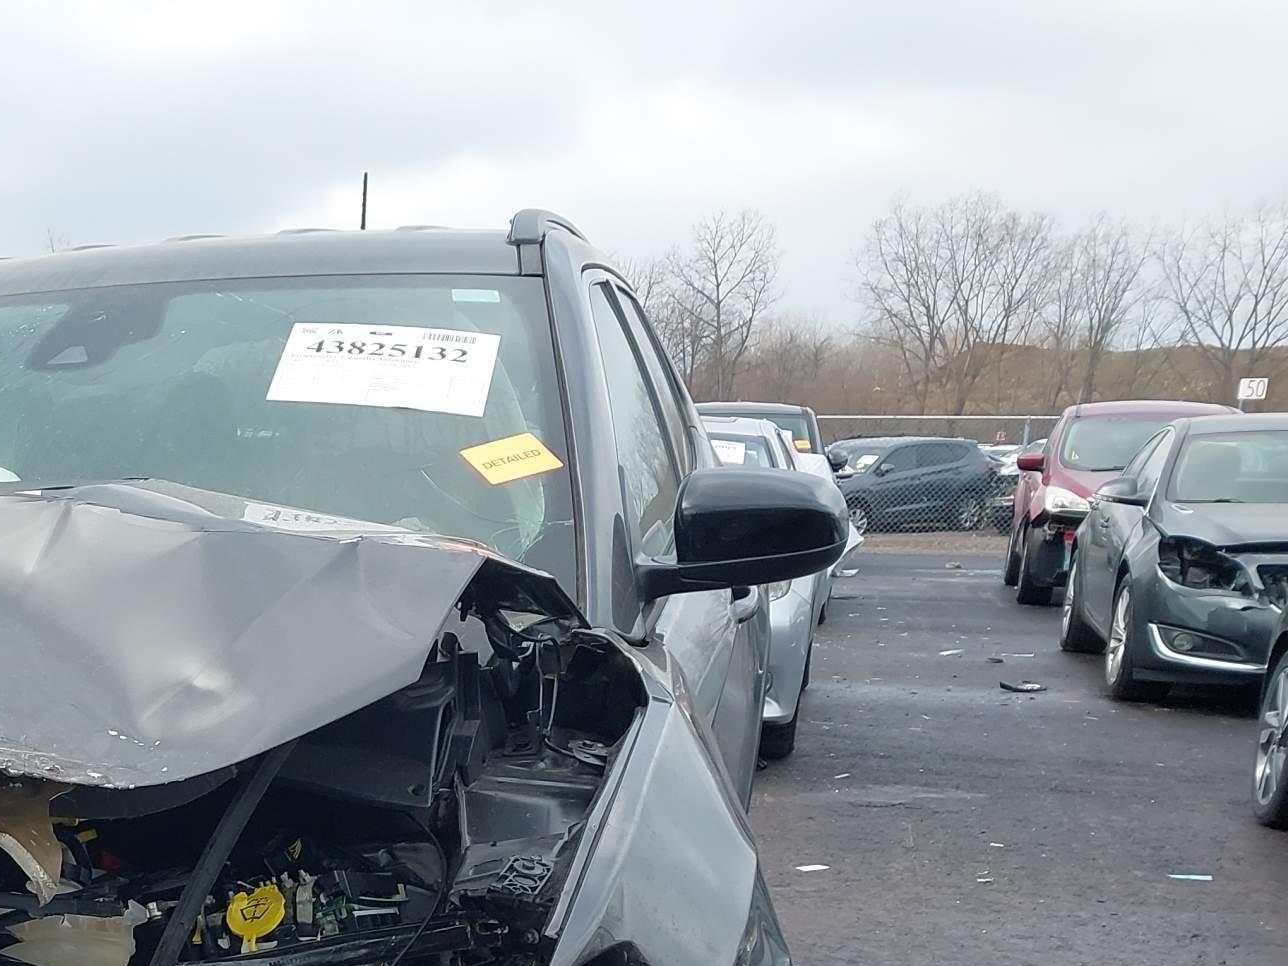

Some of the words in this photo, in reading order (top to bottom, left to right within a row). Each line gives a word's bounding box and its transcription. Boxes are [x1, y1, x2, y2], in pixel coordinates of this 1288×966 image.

[306, 338, 469, 364] 43825132
[1246, 379, 1266, 398] 50
[481, 449, 542, 470] DETAILED
